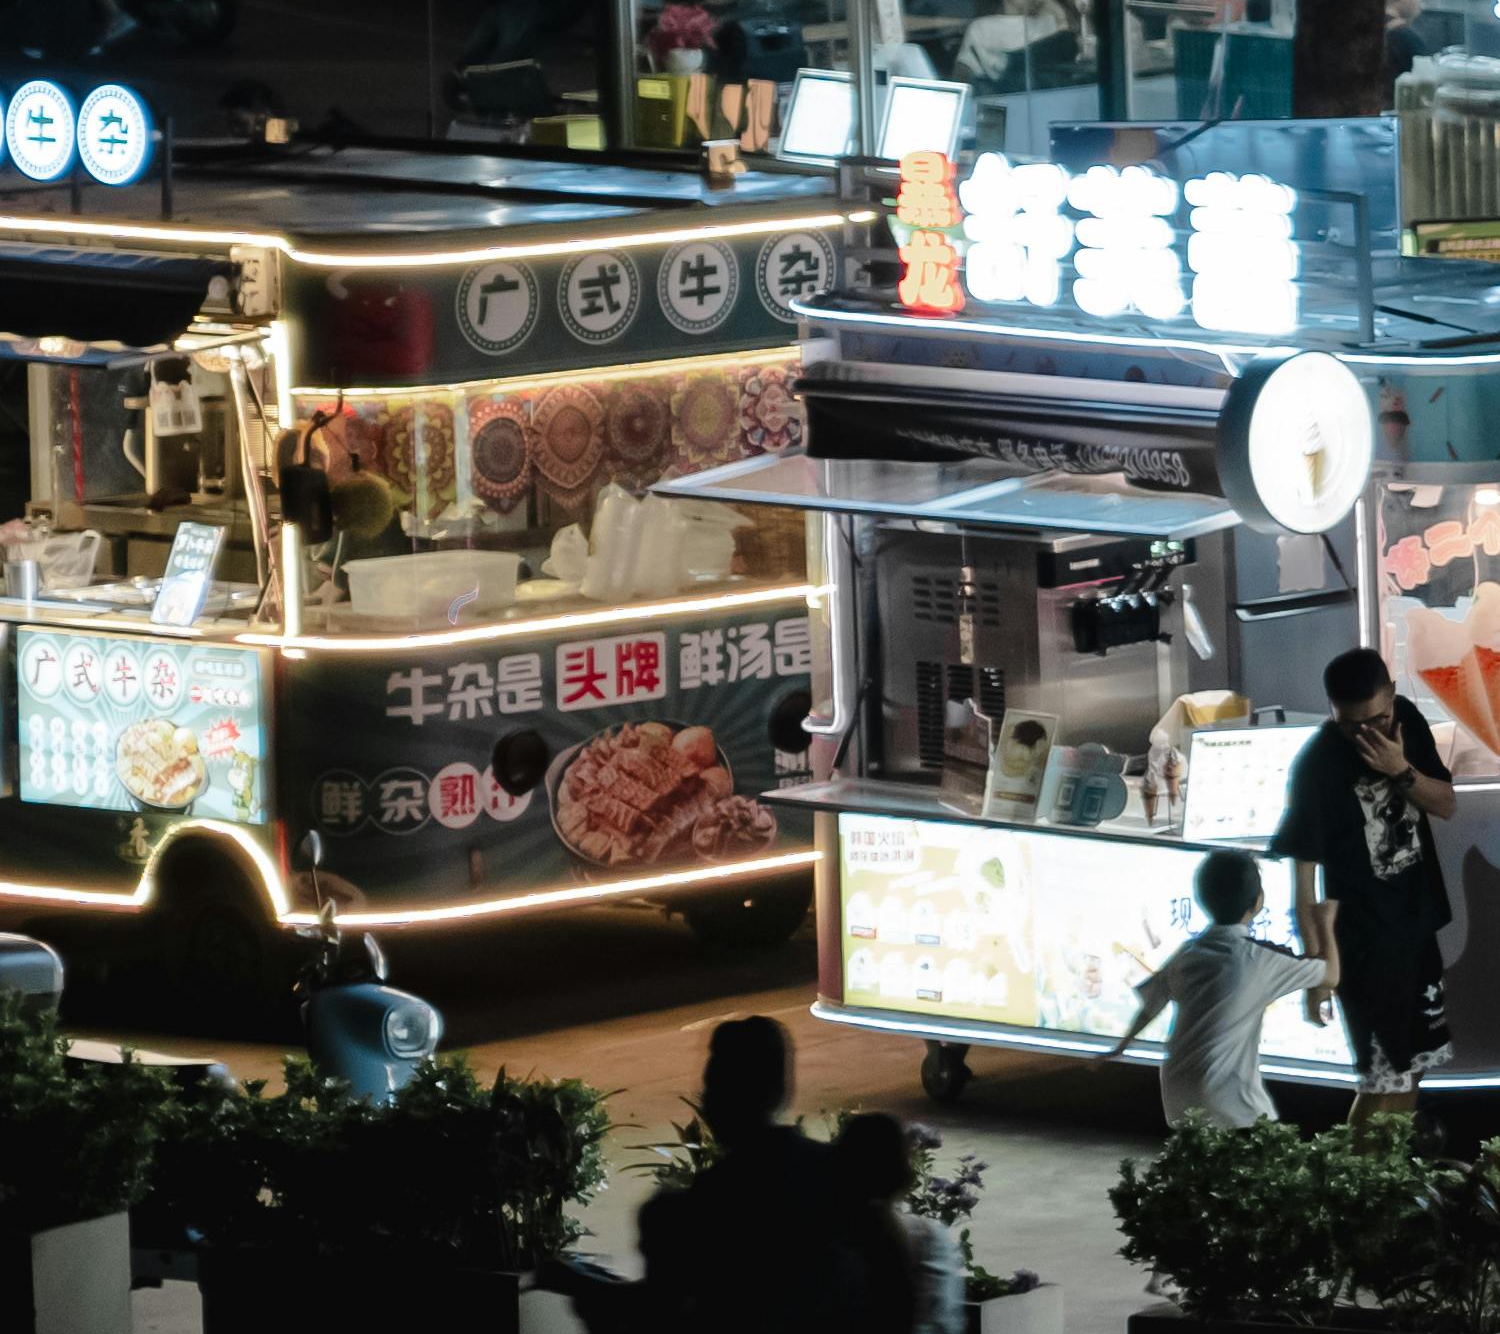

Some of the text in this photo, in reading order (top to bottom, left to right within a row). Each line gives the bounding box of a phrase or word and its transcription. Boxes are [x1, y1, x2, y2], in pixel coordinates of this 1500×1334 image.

[25, 105, 130, 155] 牛杂
[477, 243, 820, 327] 广式牛杂
[31, 650, 177, 700] 广式牛杂
[386, 652, 544, 726] 牛杂是
[562, 631, 661, 705] 头牌
